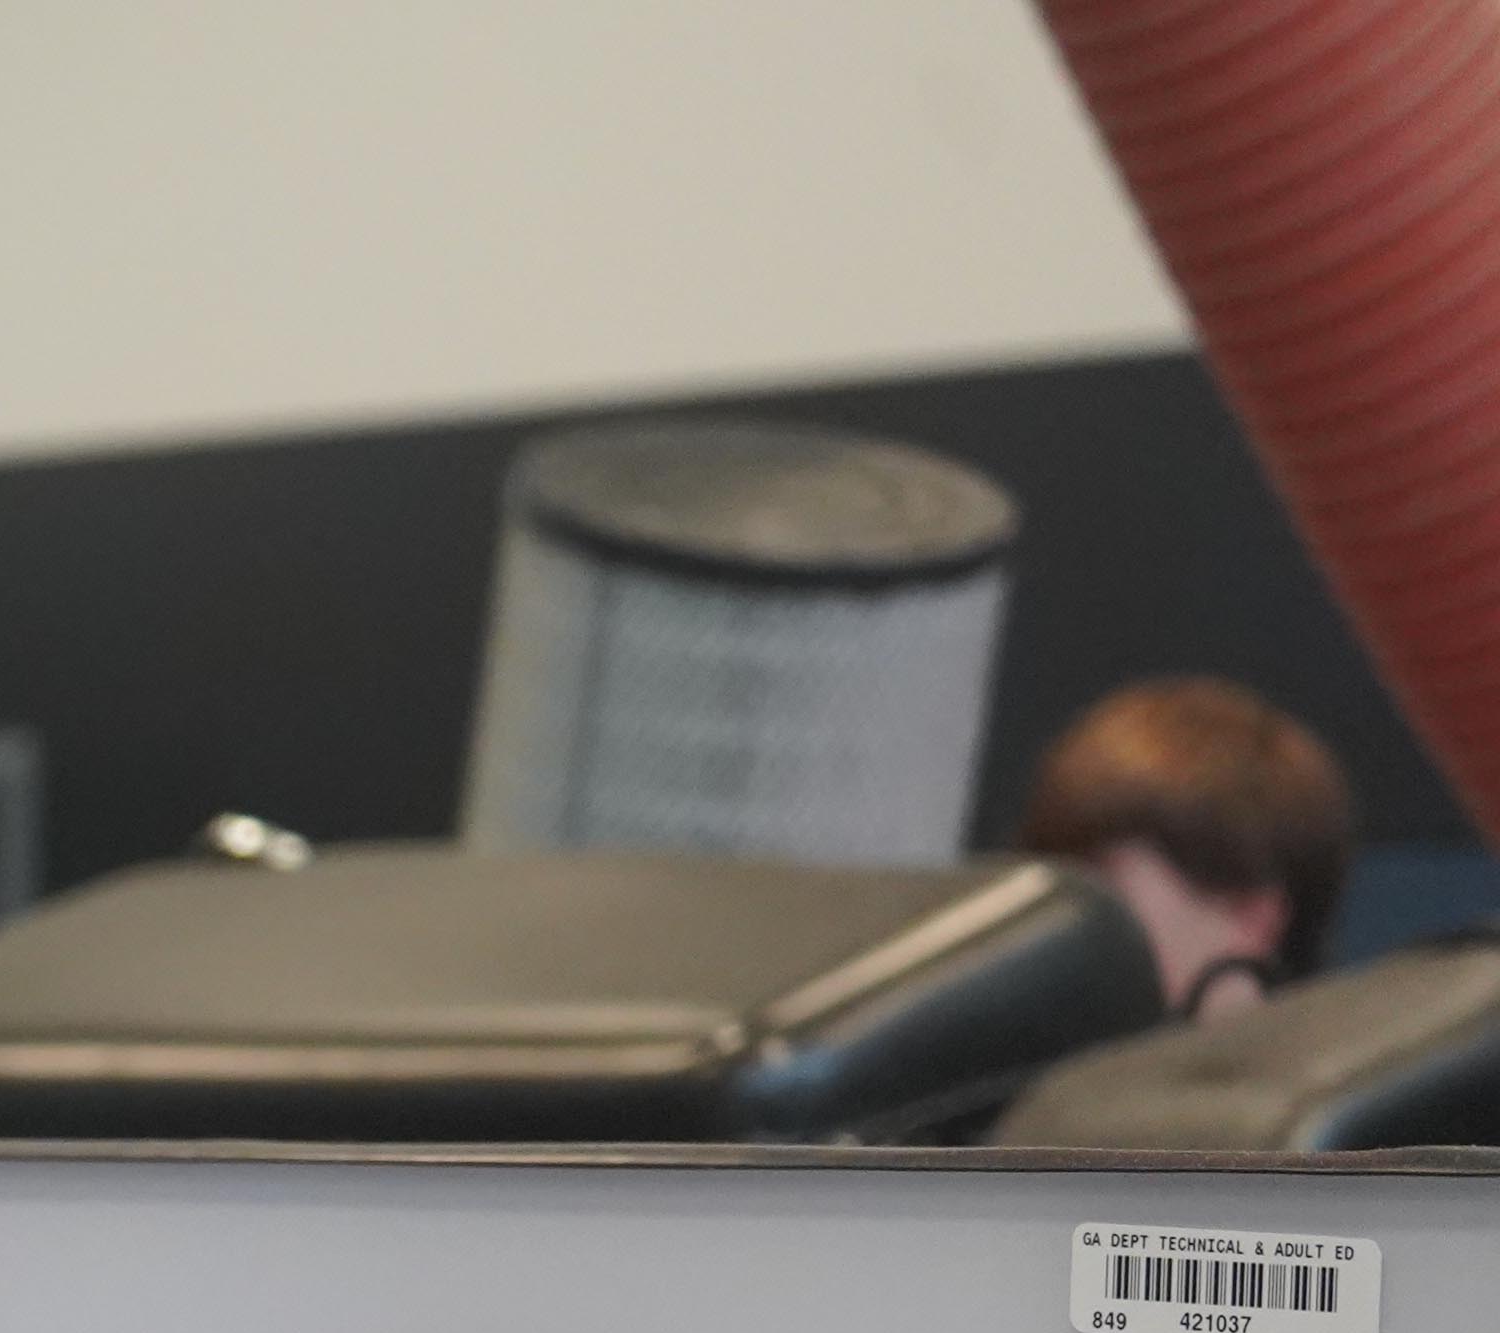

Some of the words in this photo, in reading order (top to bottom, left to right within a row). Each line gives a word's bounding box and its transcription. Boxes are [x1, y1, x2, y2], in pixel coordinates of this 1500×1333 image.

[1083, 1232, 1100, 1247] GA
[1111, 1233, 1149, 1249] DEPT
[1160, 1235, 1243, 1255] TECHNICAL
[1255, 1241, 1264, 1255] &
[1275, 1242, 1324, 1259] ADULT
[1335, 1244, 1354, 1261] ED
[1092, 1311, 1127, 1330] 849
[1180, 1312, 1252, 1333] 421037
